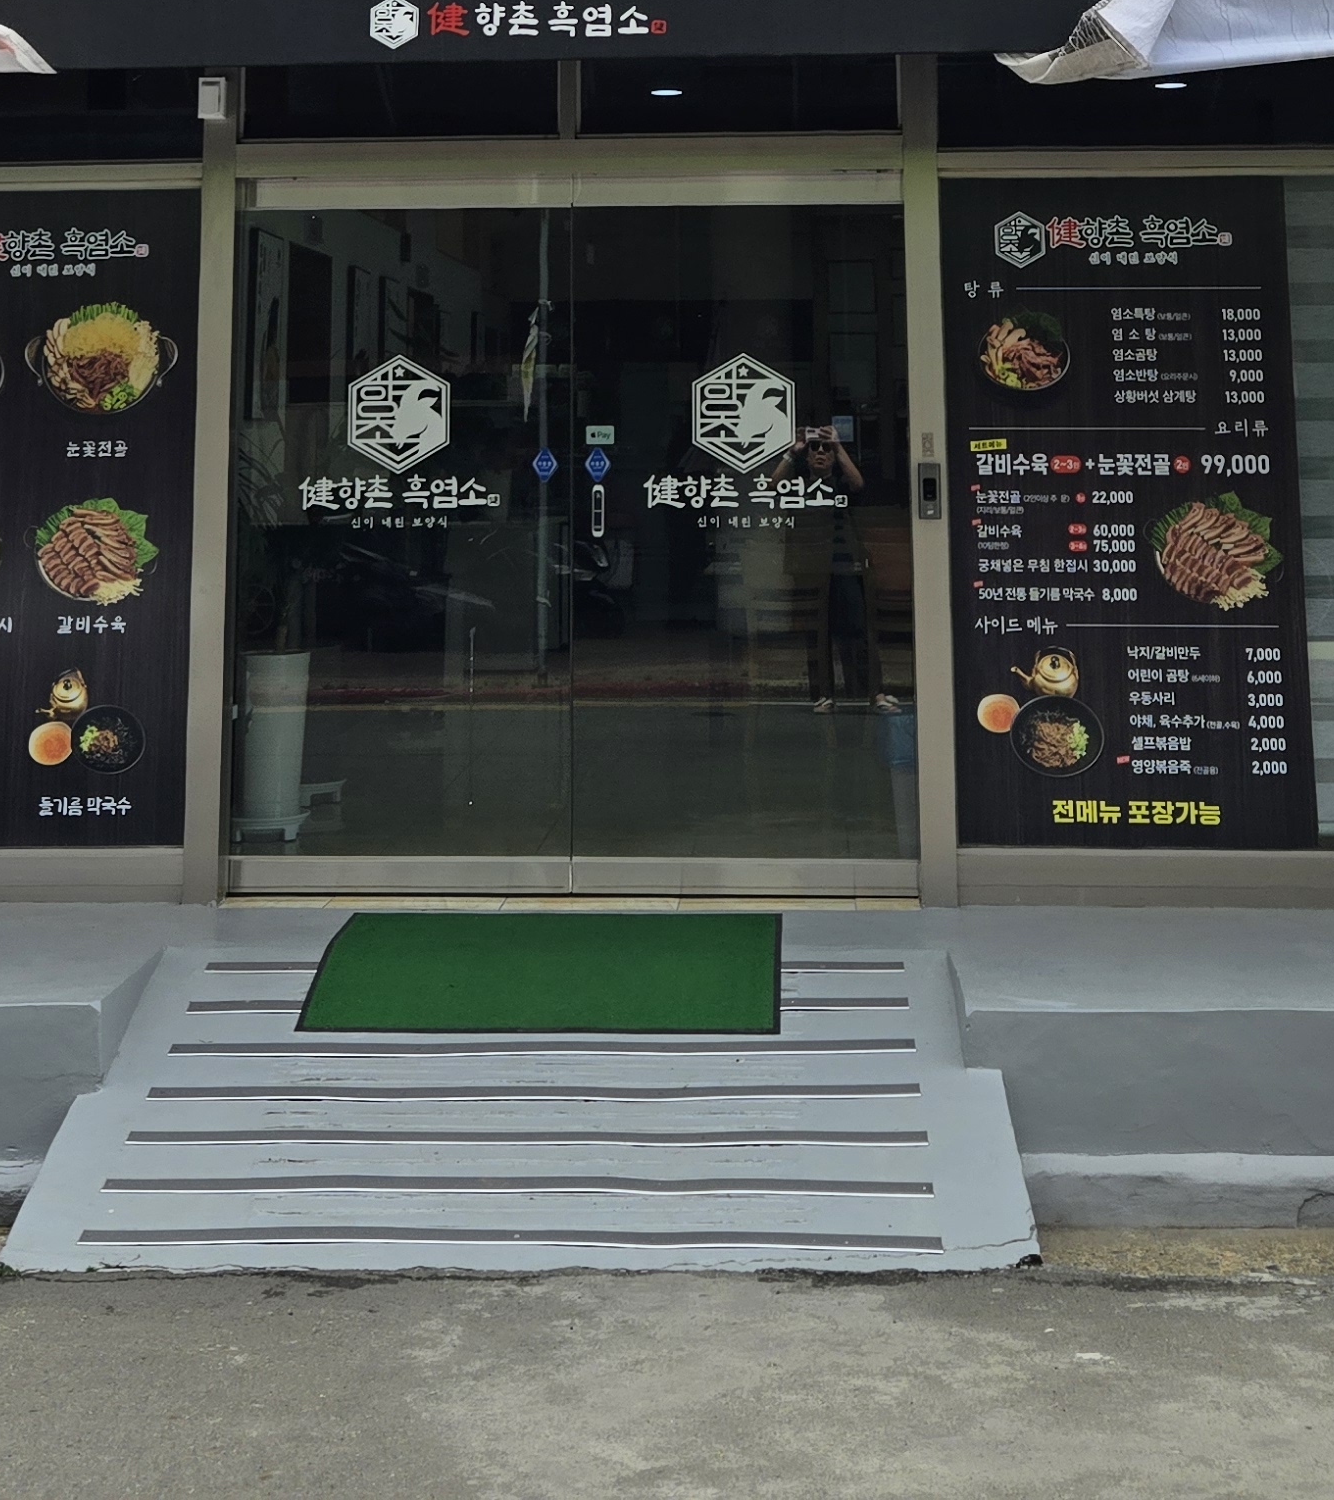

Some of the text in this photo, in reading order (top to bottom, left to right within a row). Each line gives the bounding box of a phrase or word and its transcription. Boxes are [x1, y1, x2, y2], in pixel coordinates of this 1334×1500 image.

[547, 1, 649, 38] 흑염소
[1139, 215, 1219, 249] 흑염소
[60, 227, 136, 260] 흑염소
[1221, 308, 1261, 322] 18,000
[1222, 328, 1262, 342] 13,000
[1112, 348, 1263, 363] 염소곰탕 13,000
[1113, 369, 1159, 382] 염소반탕
[1229, 369, 1264, 384] 9,000
[1114, 390, 1265, 405] 상황버섯 삼계탕 13,000
[66, 440, 129, 458] 눈꽃전골
[976, 453, 1049, 476] 갈비수육
[1097, 453, 1171, 476] 눈꽃전골
[1200, 454, 1270, 477] 99,000
[402, 474, 487, 509] 흑염소
[748, 473, 835, 509] 흑염소
[975, 490, 1021, 504] 눈꽃전골
[1092, 491, 1134, 505] 22,000
[351, 516, 448, 529] 신이 내린 보양식
[697, 516, 795, 528] 신이 내린 보양식
[976, 524, 1023, 538] 갈비수육
[1092, 524, 1135, 539] 60,000
[1093, 540, 1136, 554] 75,000
[1027, 559, 1050, 573] 무침
[1053, 559, 1089, 573] 한접시
[1093, 559, 1137, 574] 30,000
[978, 587, 1138, 603] 50년 전통 들기름 막국수 8,000
[56, 615, 127, 634] 갈비수육
[974, 615, 1059, 635] 사이드 메뉴
[1245, 648, 1281, 662] 7,000
[1127, 669, 1163, 683] 어린이
[1166, 669, 1190, 683] 곰탕
[1246, 671, 1282, 685] 6,000
[1129, 691, 1284, 708] 우동사리 3,000
[1159, 714, 1206, 729] 육수추가
[1248, 716, 1285, 730] 4,000
[1131, 736, 1287, 752] 셀프볶음밥 2,000
[1131, 759, 1192, 775] 영양볶음죽
[1251, 761, 1288, 776] 2,000
[38, 796, 132, 816] 들기름 막국수
[1052, 800, 1221, 825] 전메뉴 포장가능
